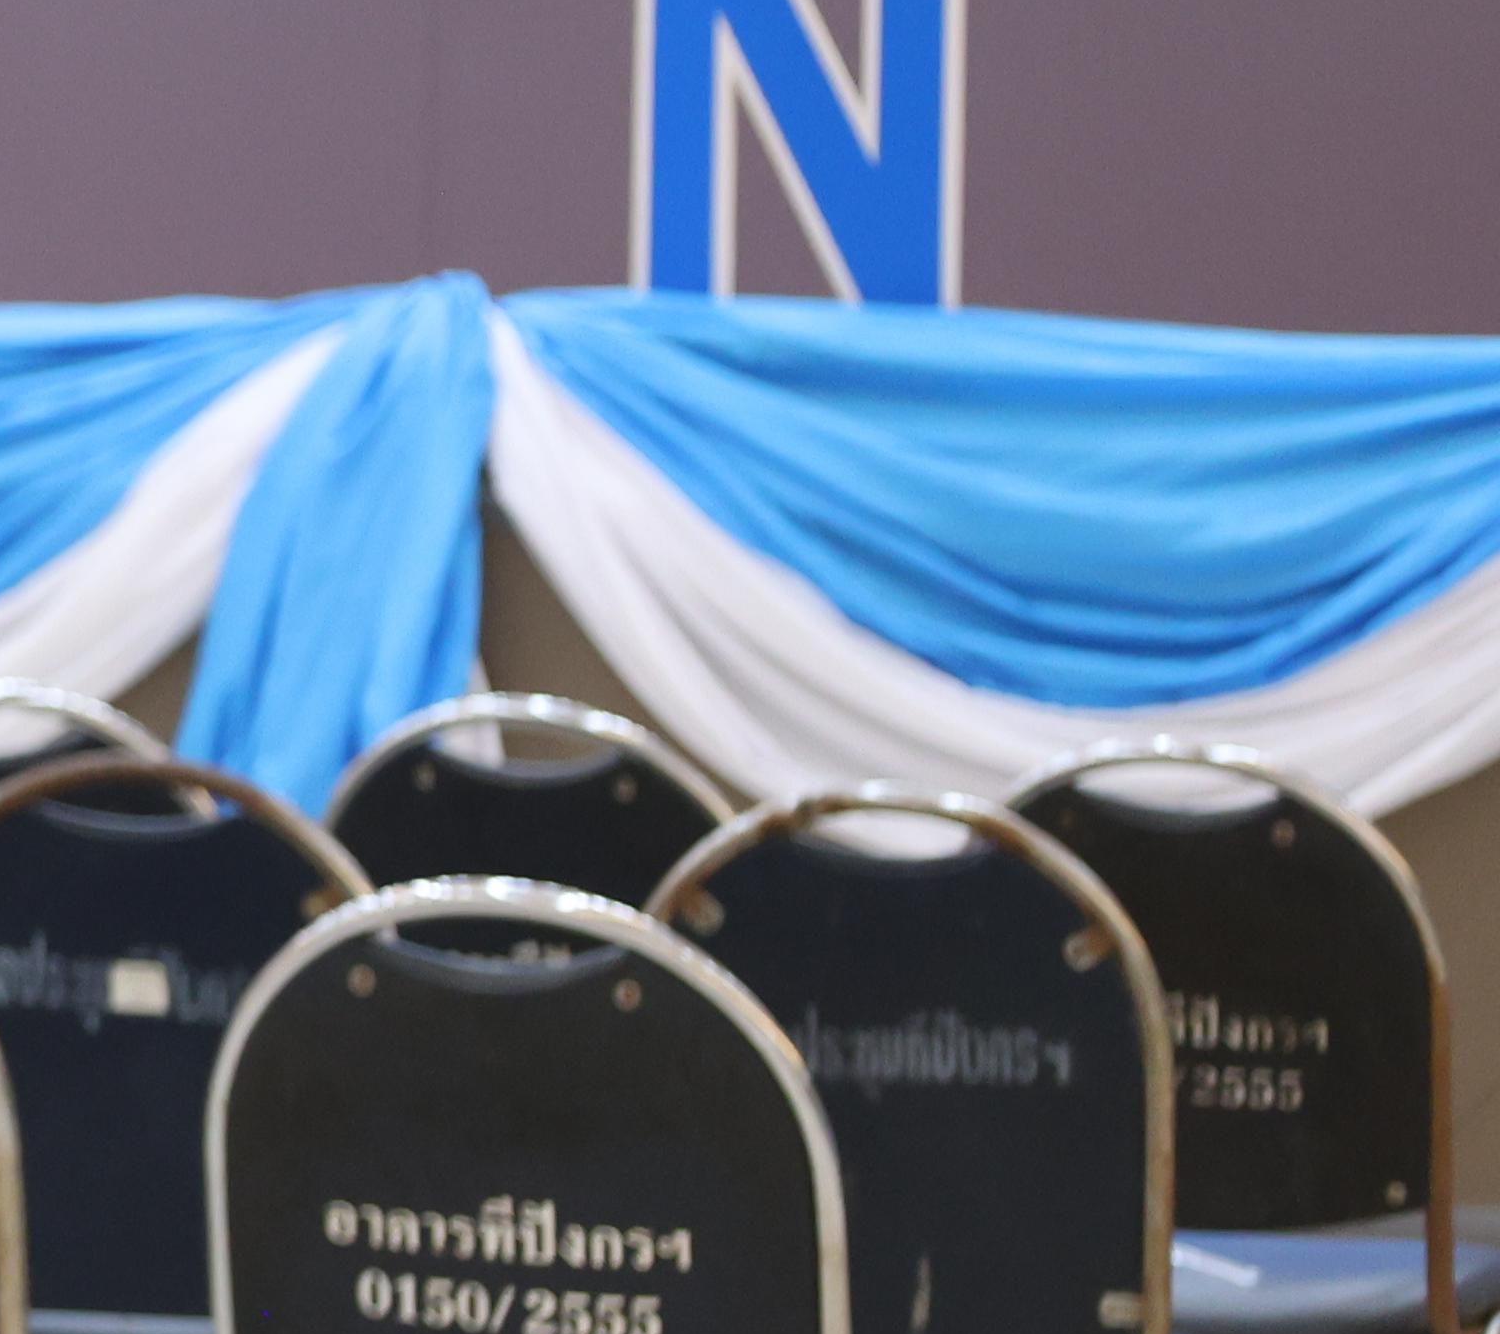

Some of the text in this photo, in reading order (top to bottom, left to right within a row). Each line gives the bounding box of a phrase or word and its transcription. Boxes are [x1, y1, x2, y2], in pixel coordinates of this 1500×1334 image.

[323, 1193, 694, 1275] อาคารทีปังกรฯ
